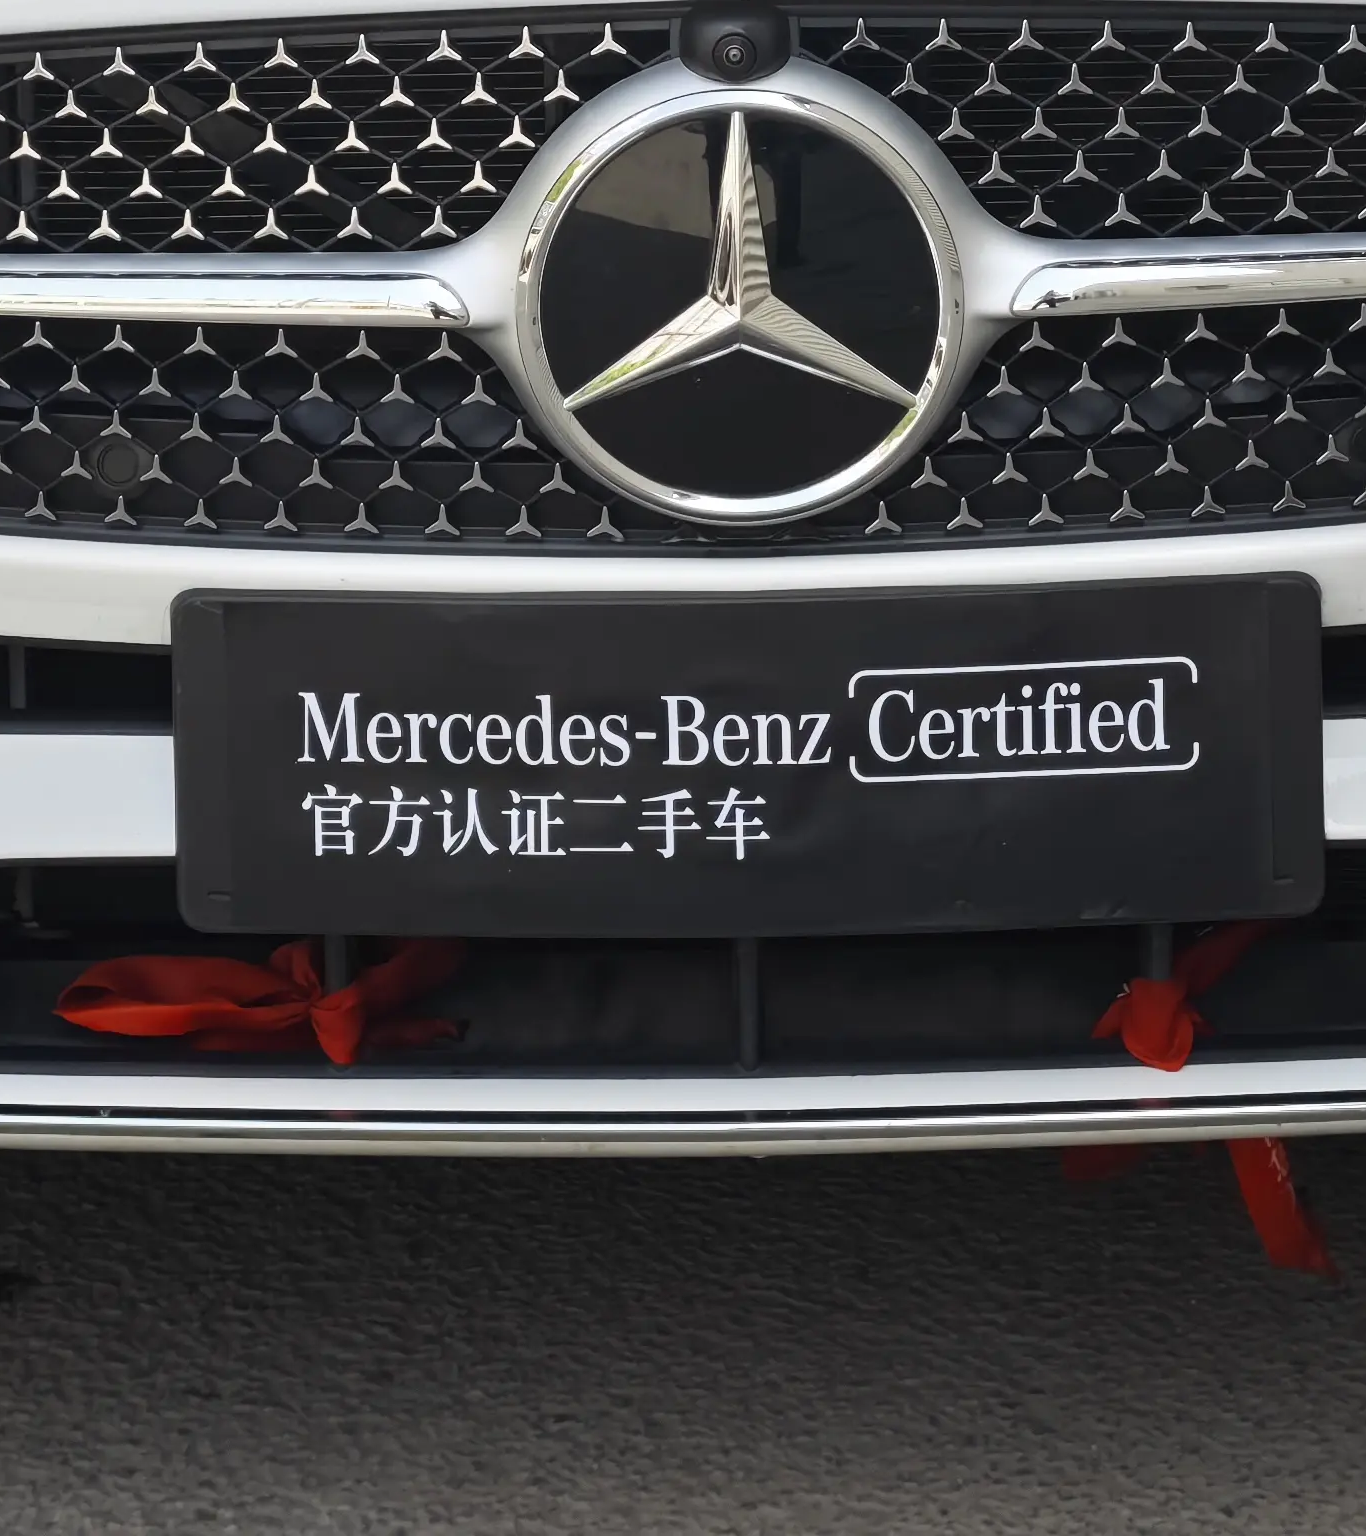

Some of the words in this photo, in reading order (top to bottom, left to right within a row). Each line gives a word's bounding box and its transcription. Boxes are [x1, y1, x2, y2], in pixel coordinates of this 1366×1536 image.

[296, 691, 832, 767] Mercedes-Benz
[868, 677, 1171, 763] Certified
[301, 783, 771, 861] 官方认证二手车
